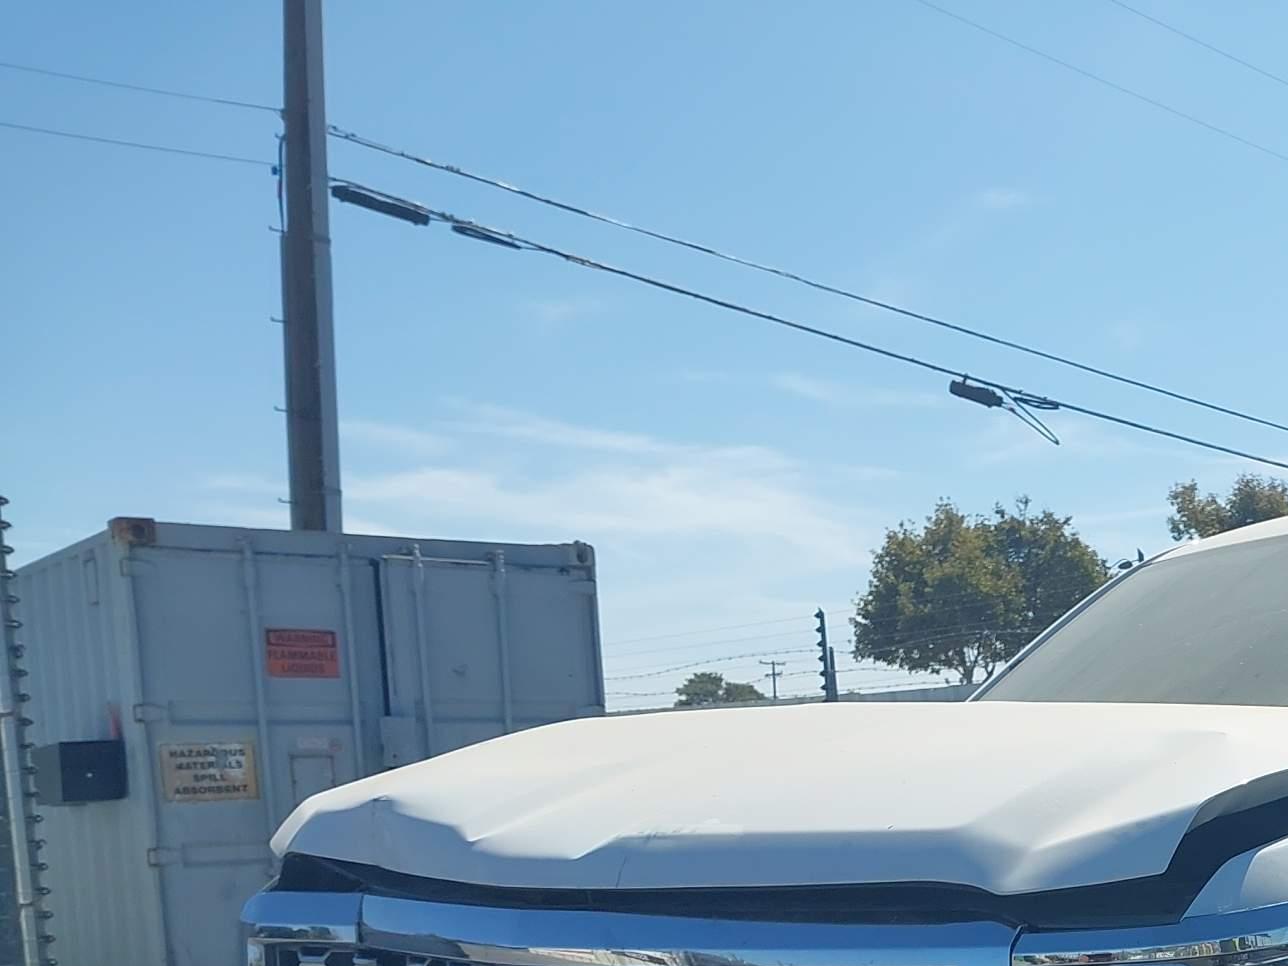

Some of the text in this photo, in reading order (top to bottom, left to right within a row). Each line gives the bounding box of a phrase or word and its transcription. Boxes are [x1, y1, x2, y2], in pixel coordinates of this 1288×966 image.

[267, 649, 337, 661] FLAMMABLE
[168, 747, 246, 758] HAZARUS
[173, 784, 249, 796] ABSORBENT
